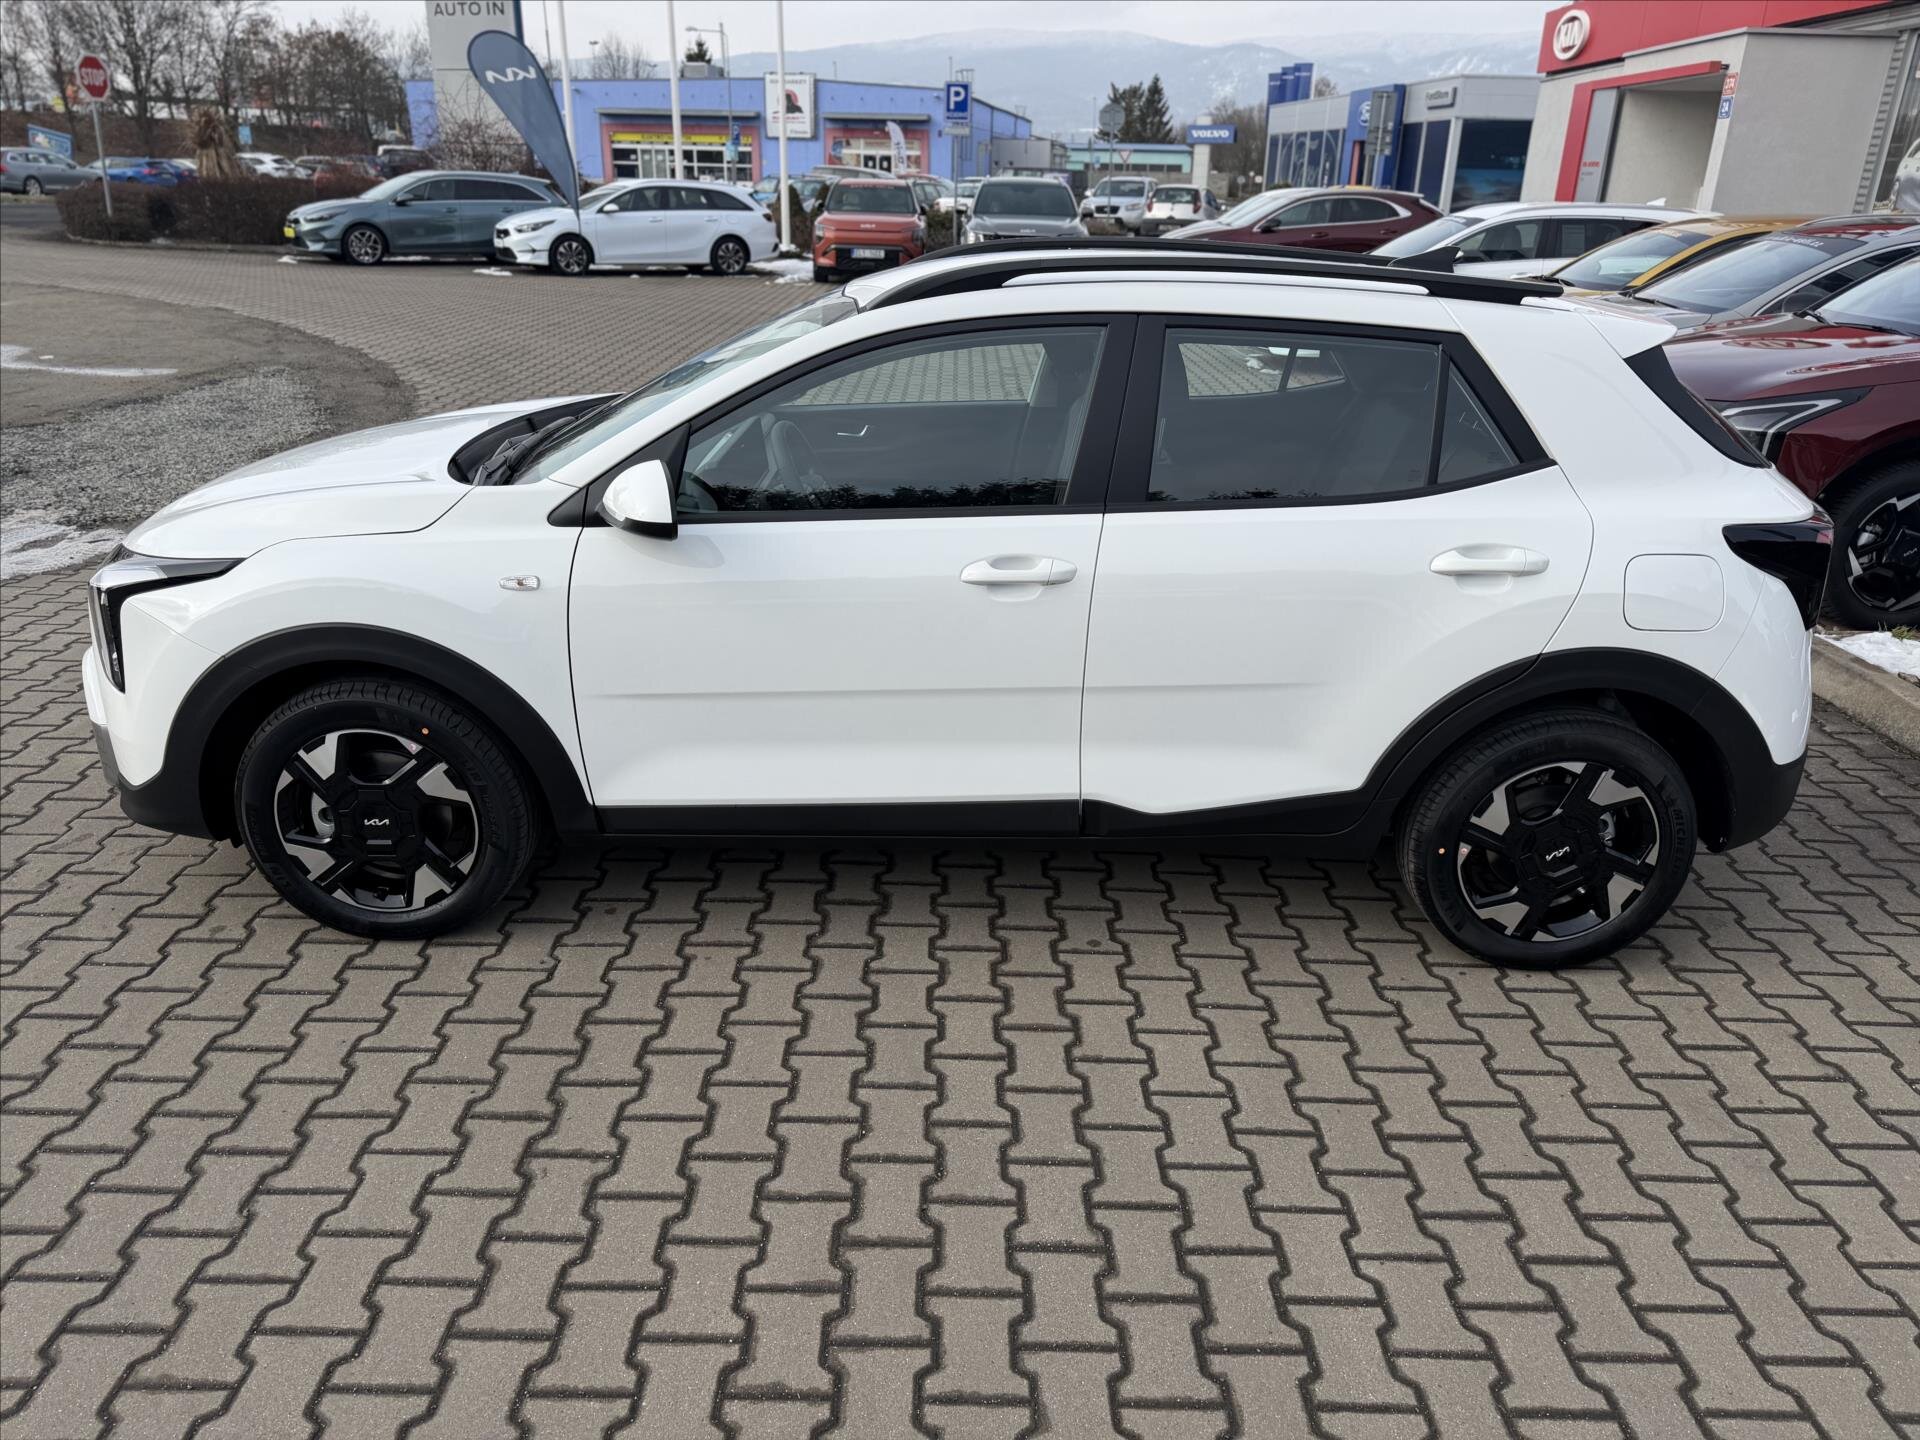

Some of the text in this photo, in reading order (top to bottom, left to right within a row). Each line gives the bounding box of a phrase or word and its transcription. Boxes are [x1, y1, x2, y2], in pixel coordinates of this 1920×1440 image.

[433, 2, 505, 16] AUTO IN
[80, 68, 106, 87] STOP
[949, 86, 966, 110] P
[1190, 129, 1229, 138] VOLVO
